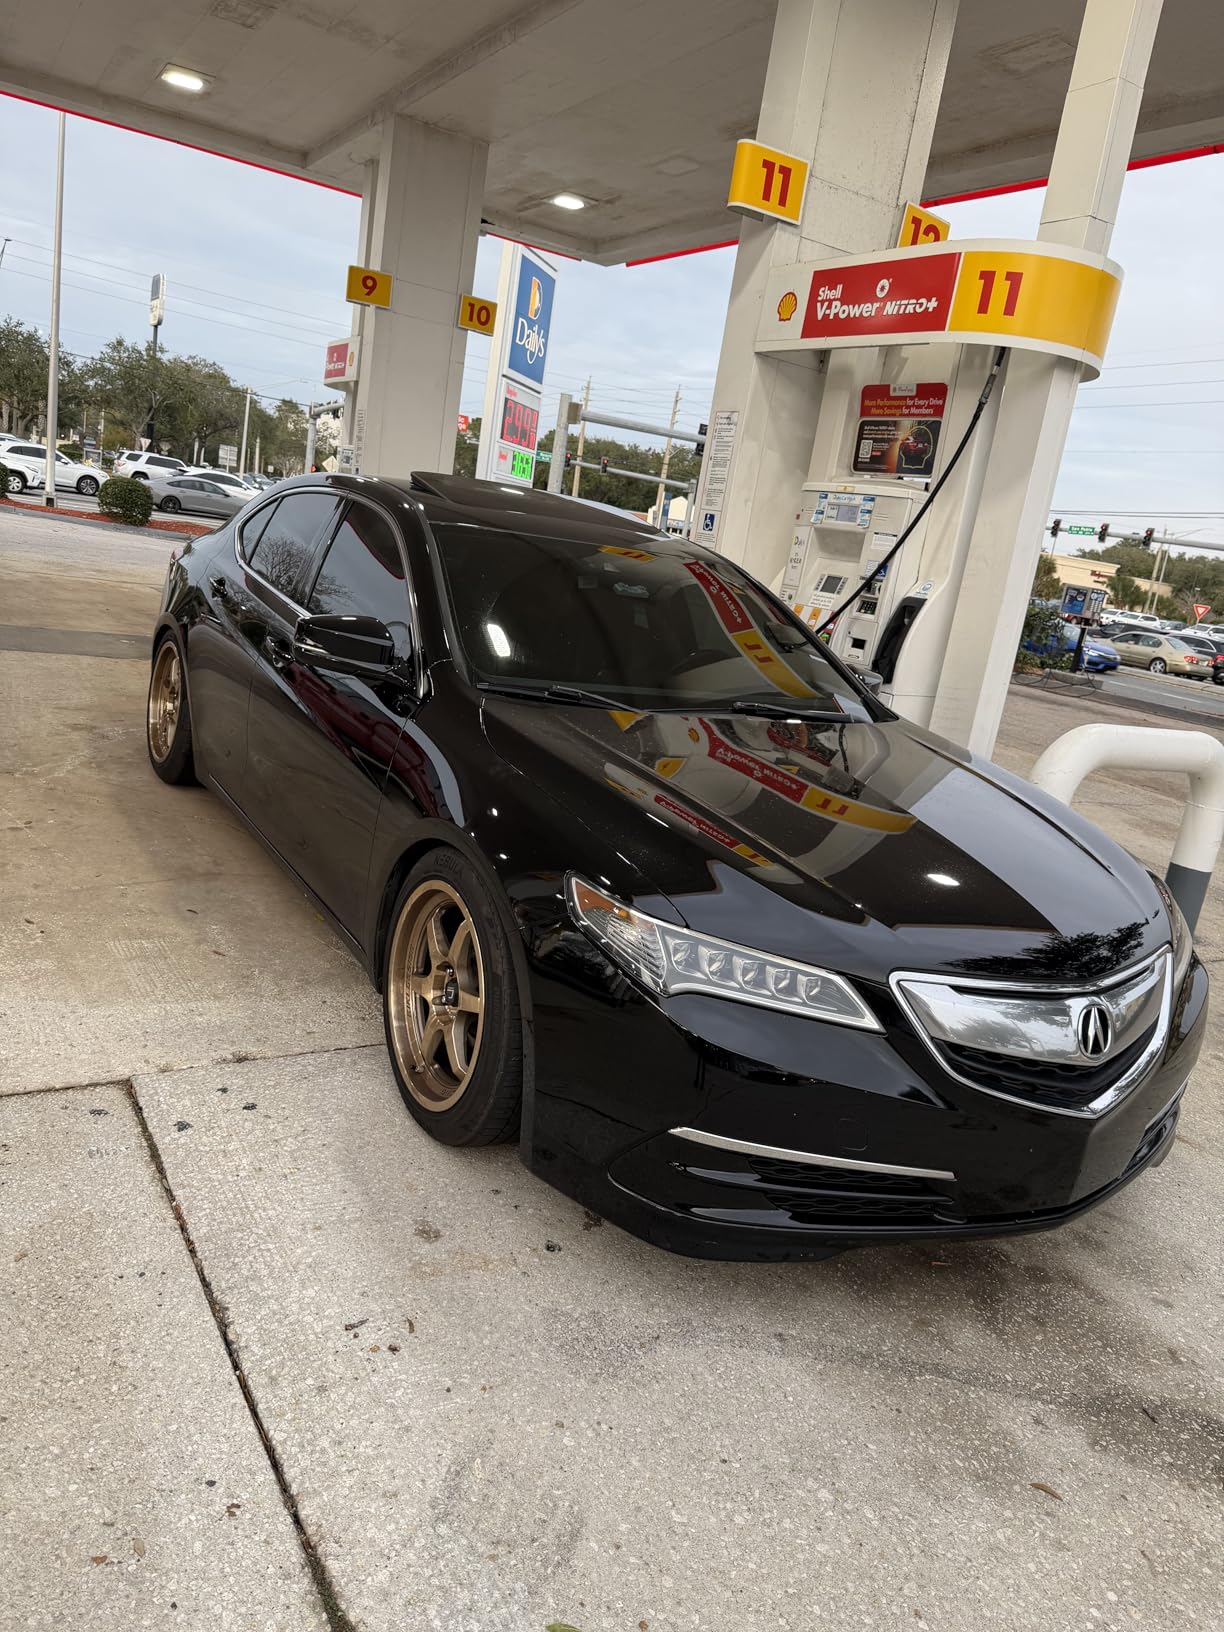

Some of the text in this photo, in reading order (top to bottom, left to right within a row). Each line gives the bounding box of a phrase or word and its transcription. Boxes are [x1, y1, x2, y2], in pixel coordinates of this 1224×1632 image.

[761, 158, 792, 208] 11
[361, 275, 378, 297] 9
[817, 284, 843, 300] Shell
[976, 270, 1024, 317] 11
[468, 302, 491, 327] 10
[816, 301, 879, 321] V-Power
[515, 317, 546, 364] Daily's
[906, 397, 914, 406] for
[914, 398, 929, 407] Every
[929, 397, 943, 405] Drive
[910, 407, 934, 415] Members
